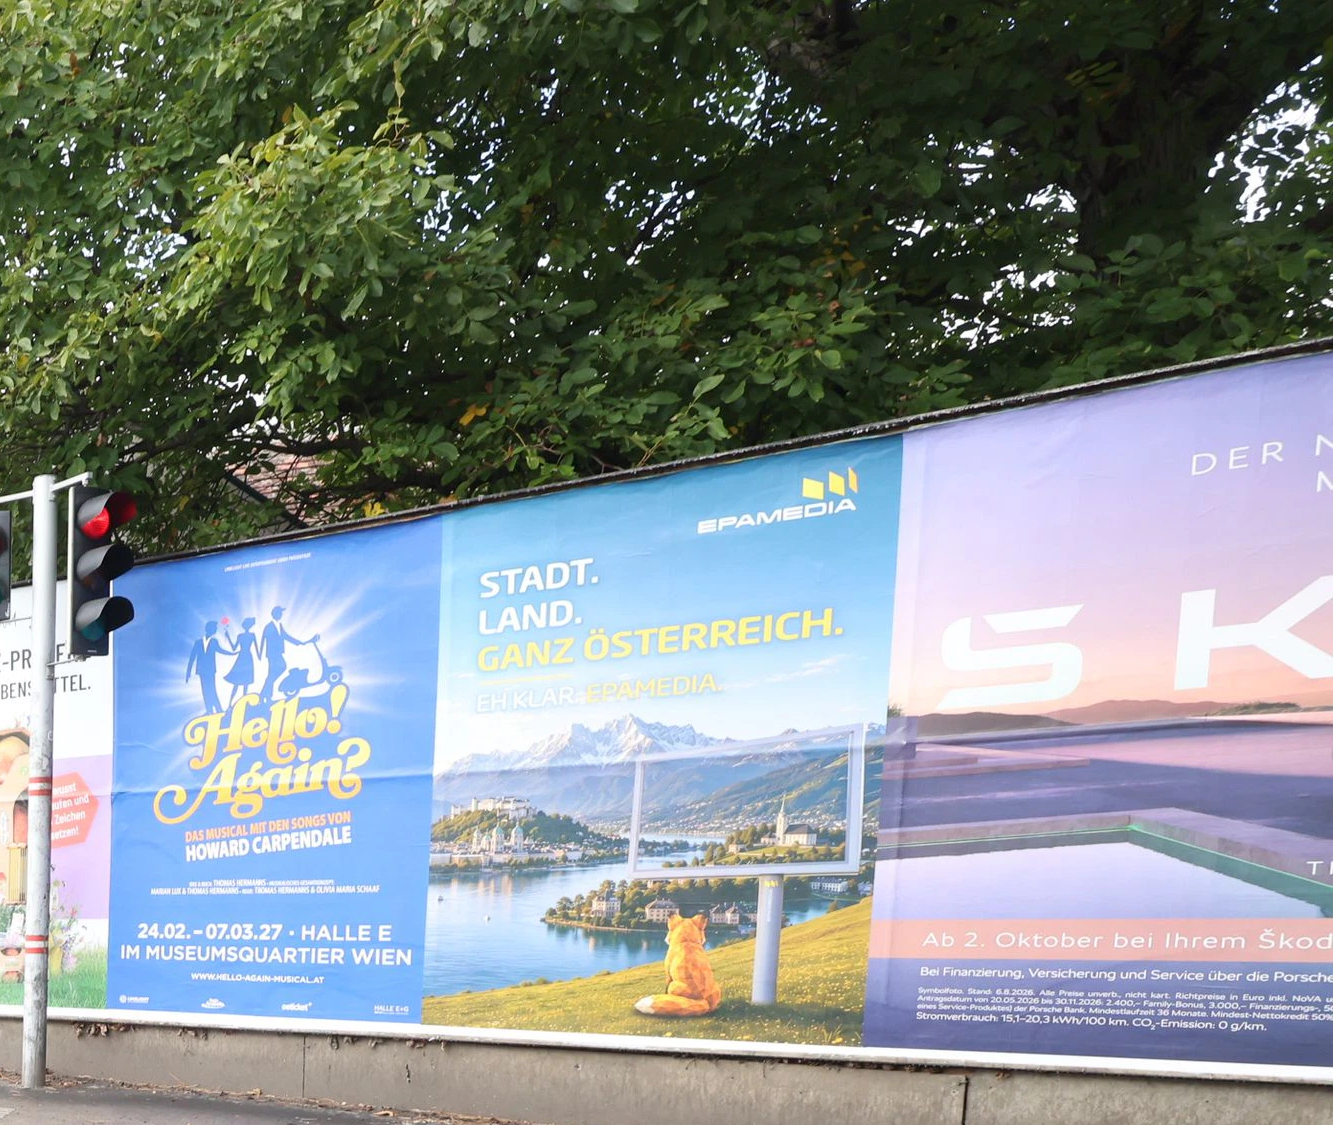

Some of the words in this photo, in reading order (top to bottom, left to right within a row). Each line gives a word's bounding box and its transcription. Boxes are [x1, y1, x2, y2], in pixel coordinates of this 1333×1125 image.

[1191, 441, 1284, 476] DER
[697, 498, 858, 534] EPAMEDIA
[479, 557, 600, 598] STADT.
[478, 600, 582, 635] LAND.
[477, 636, 576, 672] GANZ
[583, 607, 845, 661] ÖSTERREICH.
[476, 692, 507, 713] EH
[585, 672, 725, 704] EPAMEDIA.
[184, 683, 350, 770] Hello!
[153, 736, 372, 824] Again?
[74, 793, 90, 805] und
[54, 810, 86, 825] Zeichen
[185, 829, 205, 842] DAS
[206, 824, 248, 840] MUSICAL
[250, 820, 268, 835] MIT
[268, 818, 290, 833] DEN
[291, 814, 326, 830] SONGS
[327, 810, 351, 825] VON
[185, 838, 250, 861] HOWARD
[252, 825, 352, 854] CARPENDALE
[301, 924, 371, 942] HALLE
[378, 924, 392, 942] E
[921, 932, 955, 948] Ab
[964, 932, 985, 948] 2.
[995, 931, 1103, 948] Oktober
[1114, 933, 1153, 949] bei
[1165, 932, 1246, 949] Ihrem
[120, 944, 140, 960] IM
[145, 945, 345, 965] MUSEUMSQUARTIER
[351, 948, 413, 966] WIEN
[191, 972, 326, 984] WWW.HELLO-AGAIN-MUSICAL.AT
[920, 967, 940, 977] Bei
[942, 967, 1025, 979] Finanzierung,
[1028, 968, 1116, 981] Versicherung
[1120, 970, 1147, 980] und
[1150, 969, 1205, 981] Service
[1208, 971, 1242, 982] über
[1246, 971, 1270, 982] die
[917, 986, 964, 995] Symbolfoto.
[1058, 989, 1084, 997] Preise
[1125, 991, 1147, 999] nicht
[1150, 991, 1171, 999] kart.
[1175, 992, 1226, 1001] Richtpreise
[1229, 993, 1238, 1001] in
[1242, 993, 1265, 1001] Euro
[1292, 995, 1322, 1003] NoVA
[917, 994, 973, 1003] Antragsdatum
[916, 1011, 999, 1022] Stromverbrauch:
[1053, 1015, 1106, 1026] kWh/100
[1109, 1017, 1130, 1026] km.
[1218, 1020, 1228, 1030] 0
[1231, 1021, 1267, 1032] g/km.
[938, 1003, 1013, 1012] Service-Produktes)
[1029, 1006, 1063, 1014] Porsche
[1064, 1006, 1087, 1014] Bank.
[1089, 1007, 1155, 1016] Mindestlaufzeit
[1171, 1009, 1208, 1018] Monate.
[1210, 1010, 1309, 1020] Mindest-Nettokredit
